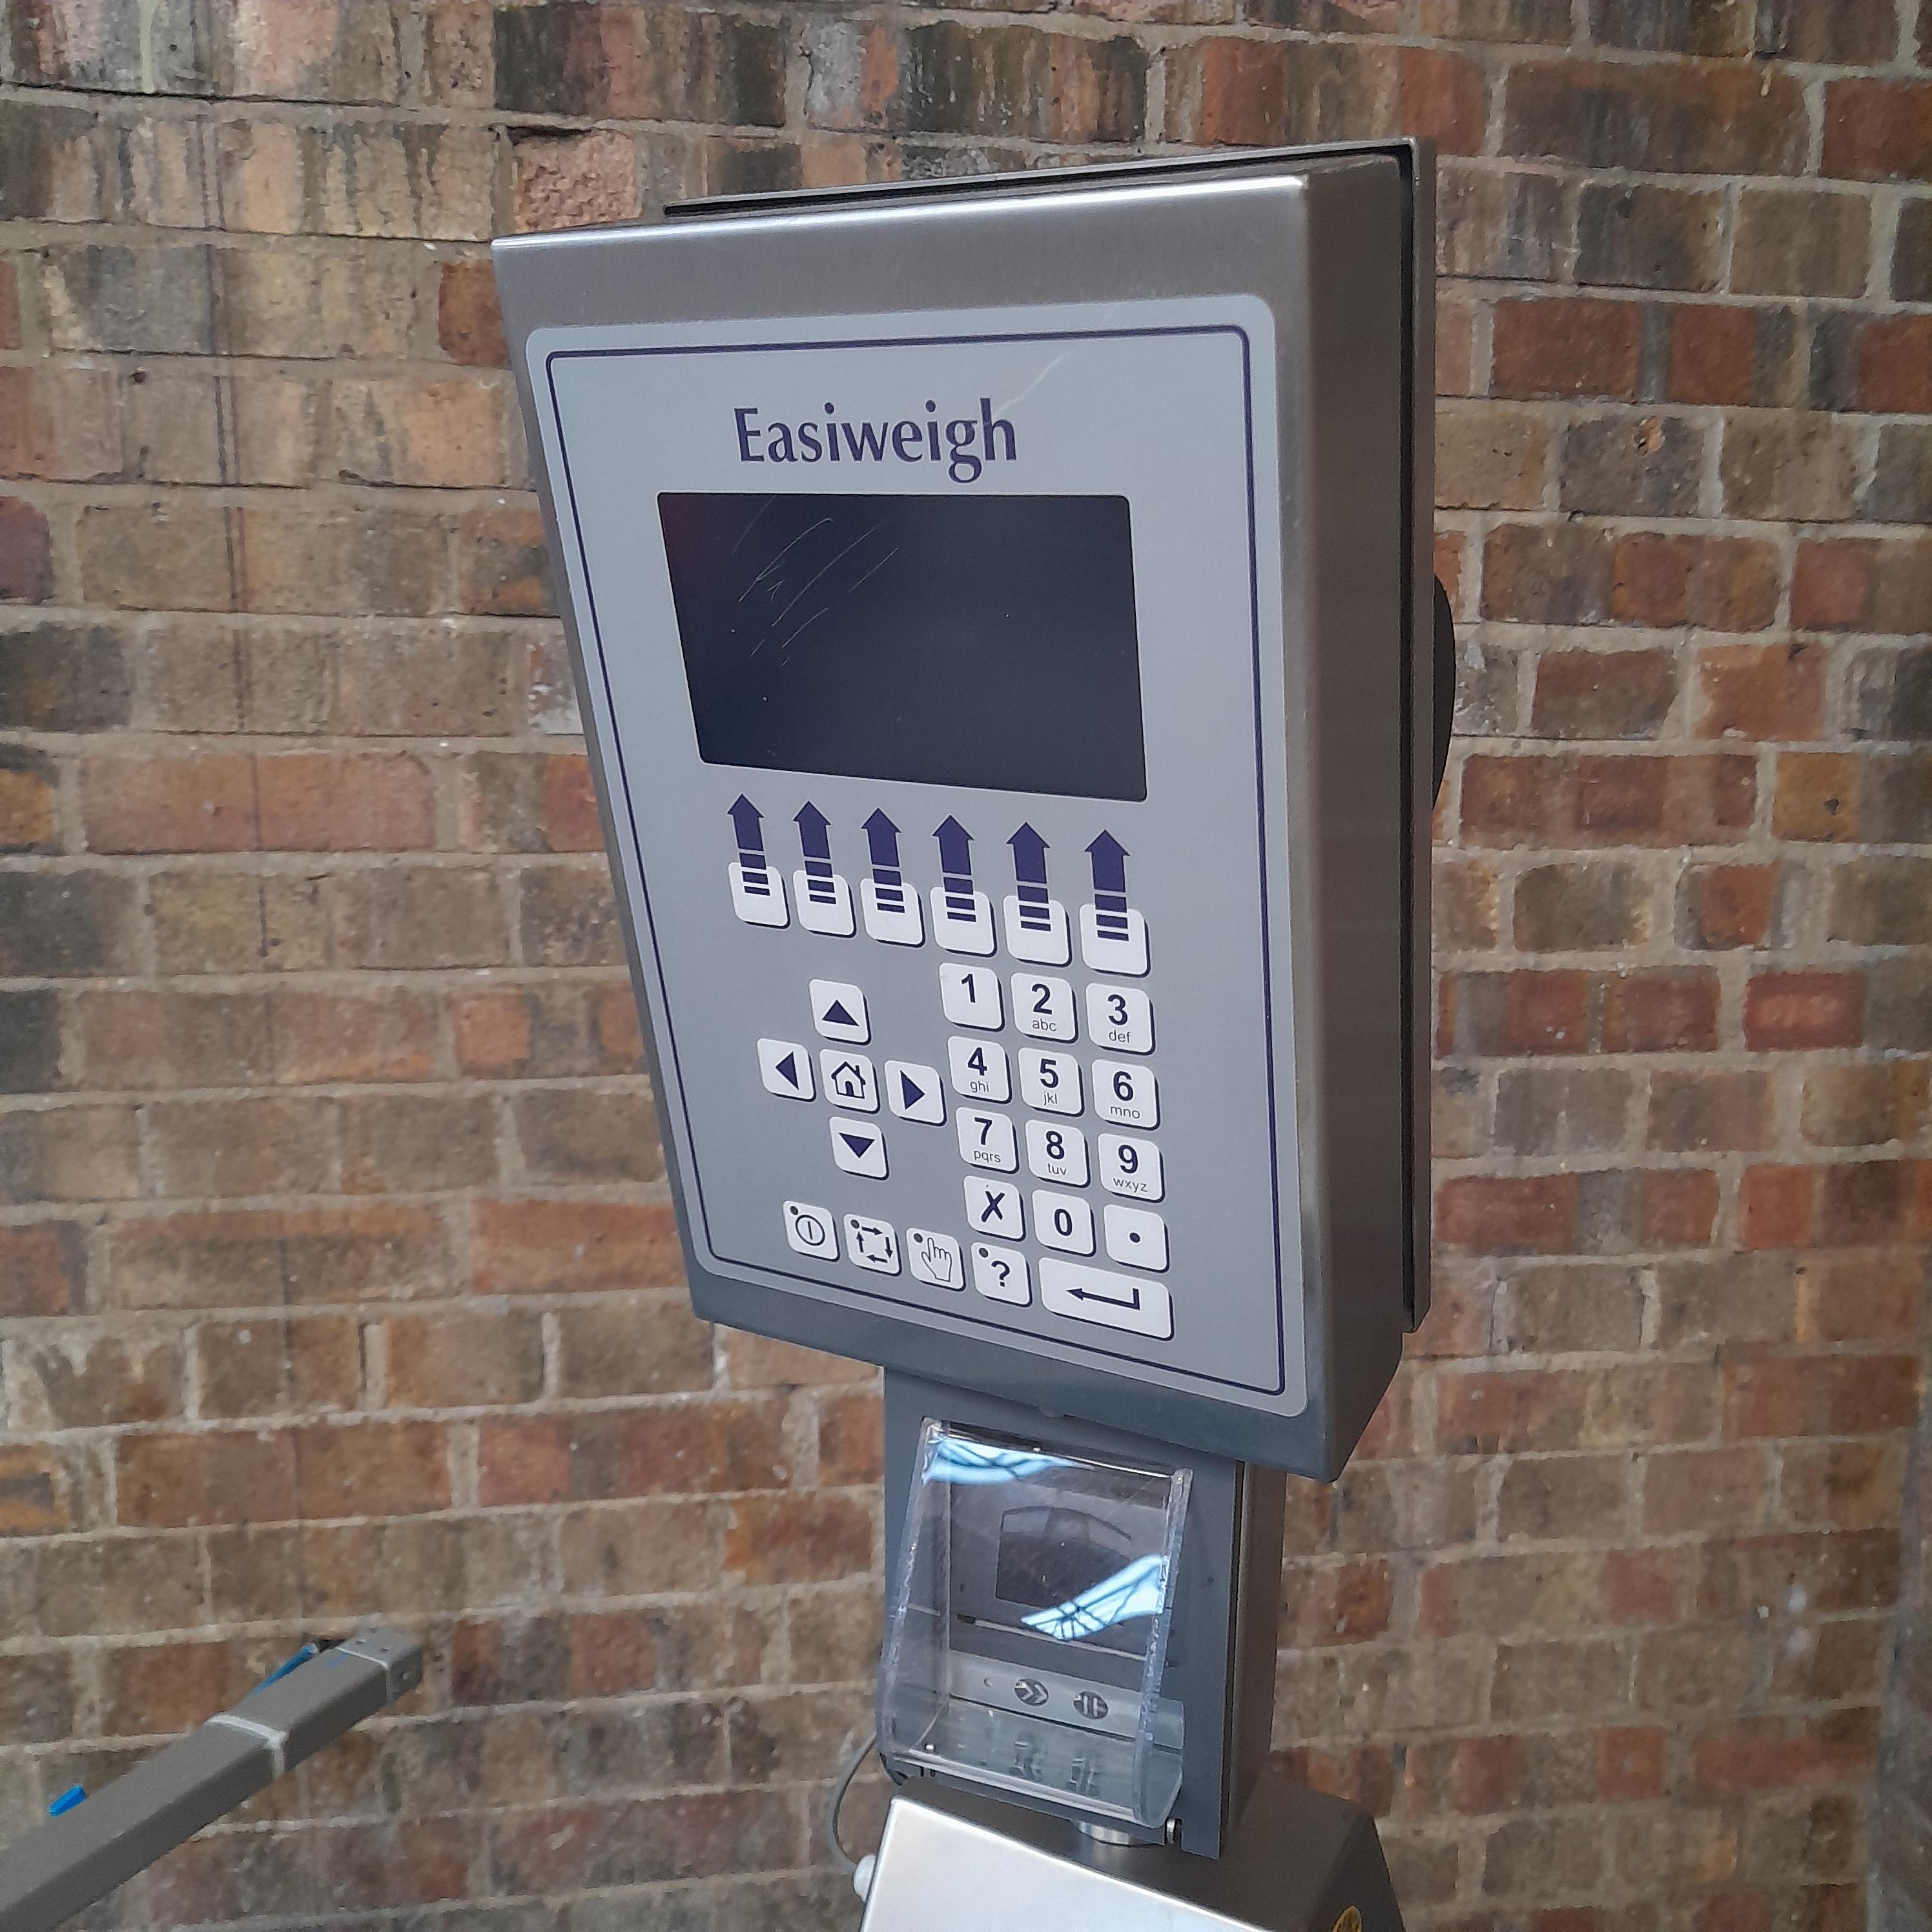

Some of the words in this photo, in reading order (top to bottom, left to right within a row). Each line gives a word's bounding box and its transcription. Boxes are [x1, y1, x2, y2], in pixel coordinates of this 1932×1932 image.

[734, 397, 1016, 483] Easiweigh
[961, 974, 976, 1003] 1
[1031, 984, 1053, 1014] 2
[1107, 994, 1128, 1025] 3
[1032, 1018, 1057, 1033] abc
[1109, 1031, 1131, 1043] def
[967, 1047, 987, 1076] 4
[1040, 1058, 1059, 1088] 5
[970, 1080, 989, 1093] ghi
[1043, 1092, 1058, 1105] jkl
[1113, 1071, 1134, 1101] 6
[1110, 1105, 1140, 1120] mno
[974, 1117, 992, 1146] 7
[1046, 1131, 1065, 1160] 8
[973, 1149, 1002, 1163] pqrs
[1047, 1164, 1067, 1176] tuv
[1118, 1145, 1138, 1174] 9
[1113, 1177, 1148, 1193] wxyz
[1054, 1208, 1073, 1237] 0
[991, 1260, 1011, 1288] ?
